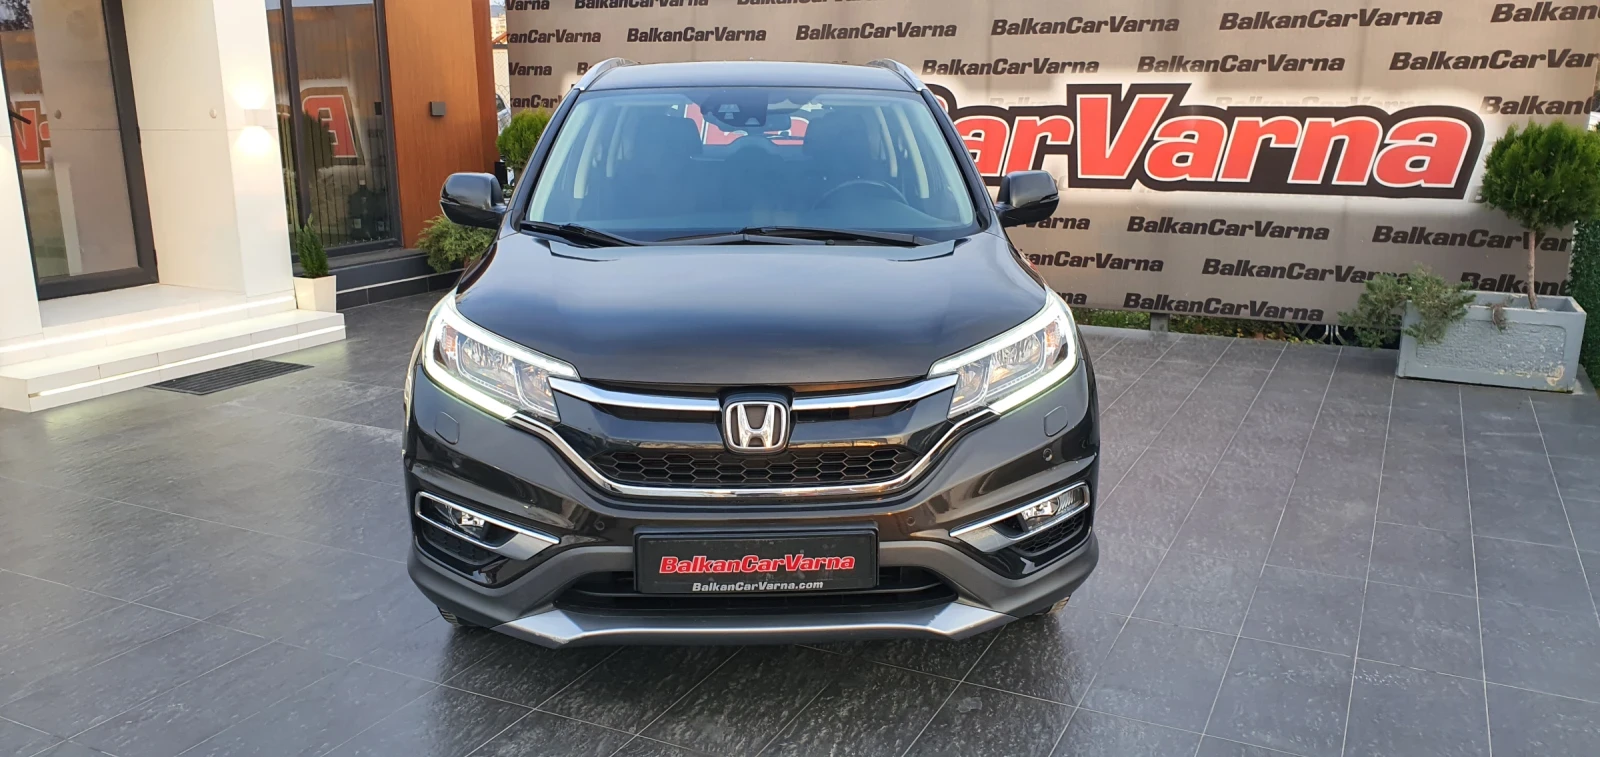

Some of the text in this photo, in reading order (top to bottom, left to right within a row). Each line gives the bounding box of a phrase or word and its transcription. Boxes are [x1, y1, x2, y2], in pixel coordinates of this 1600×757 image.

[1219, 8, 1443, 31] BalkanCarVarna
[1490, 1, 1600, 23] Balkan
[627, 26, 767, 43] BalkanCarVarna
[796, 22, 957, 41] BalkanCarVarna
[990, 16, 1180, 36] BalkanCarVarna
[921, 57, 1099, 76] BalkanCarVarna
[1137, 53, 1346, 74] BalkanCarVarna
[935, 93, 1472, 189] arVarna
[1126, 216, 1330, 241] BalkanCarVarna
[1022, 250, 1164, 272] anCarVarna
[1123, 292, 1325, 322] BalkanCarVarna
[659, 554, 856, 574] BalkanCarVarna
[692, 581, 824, 592] BalkanCarVarna.com
